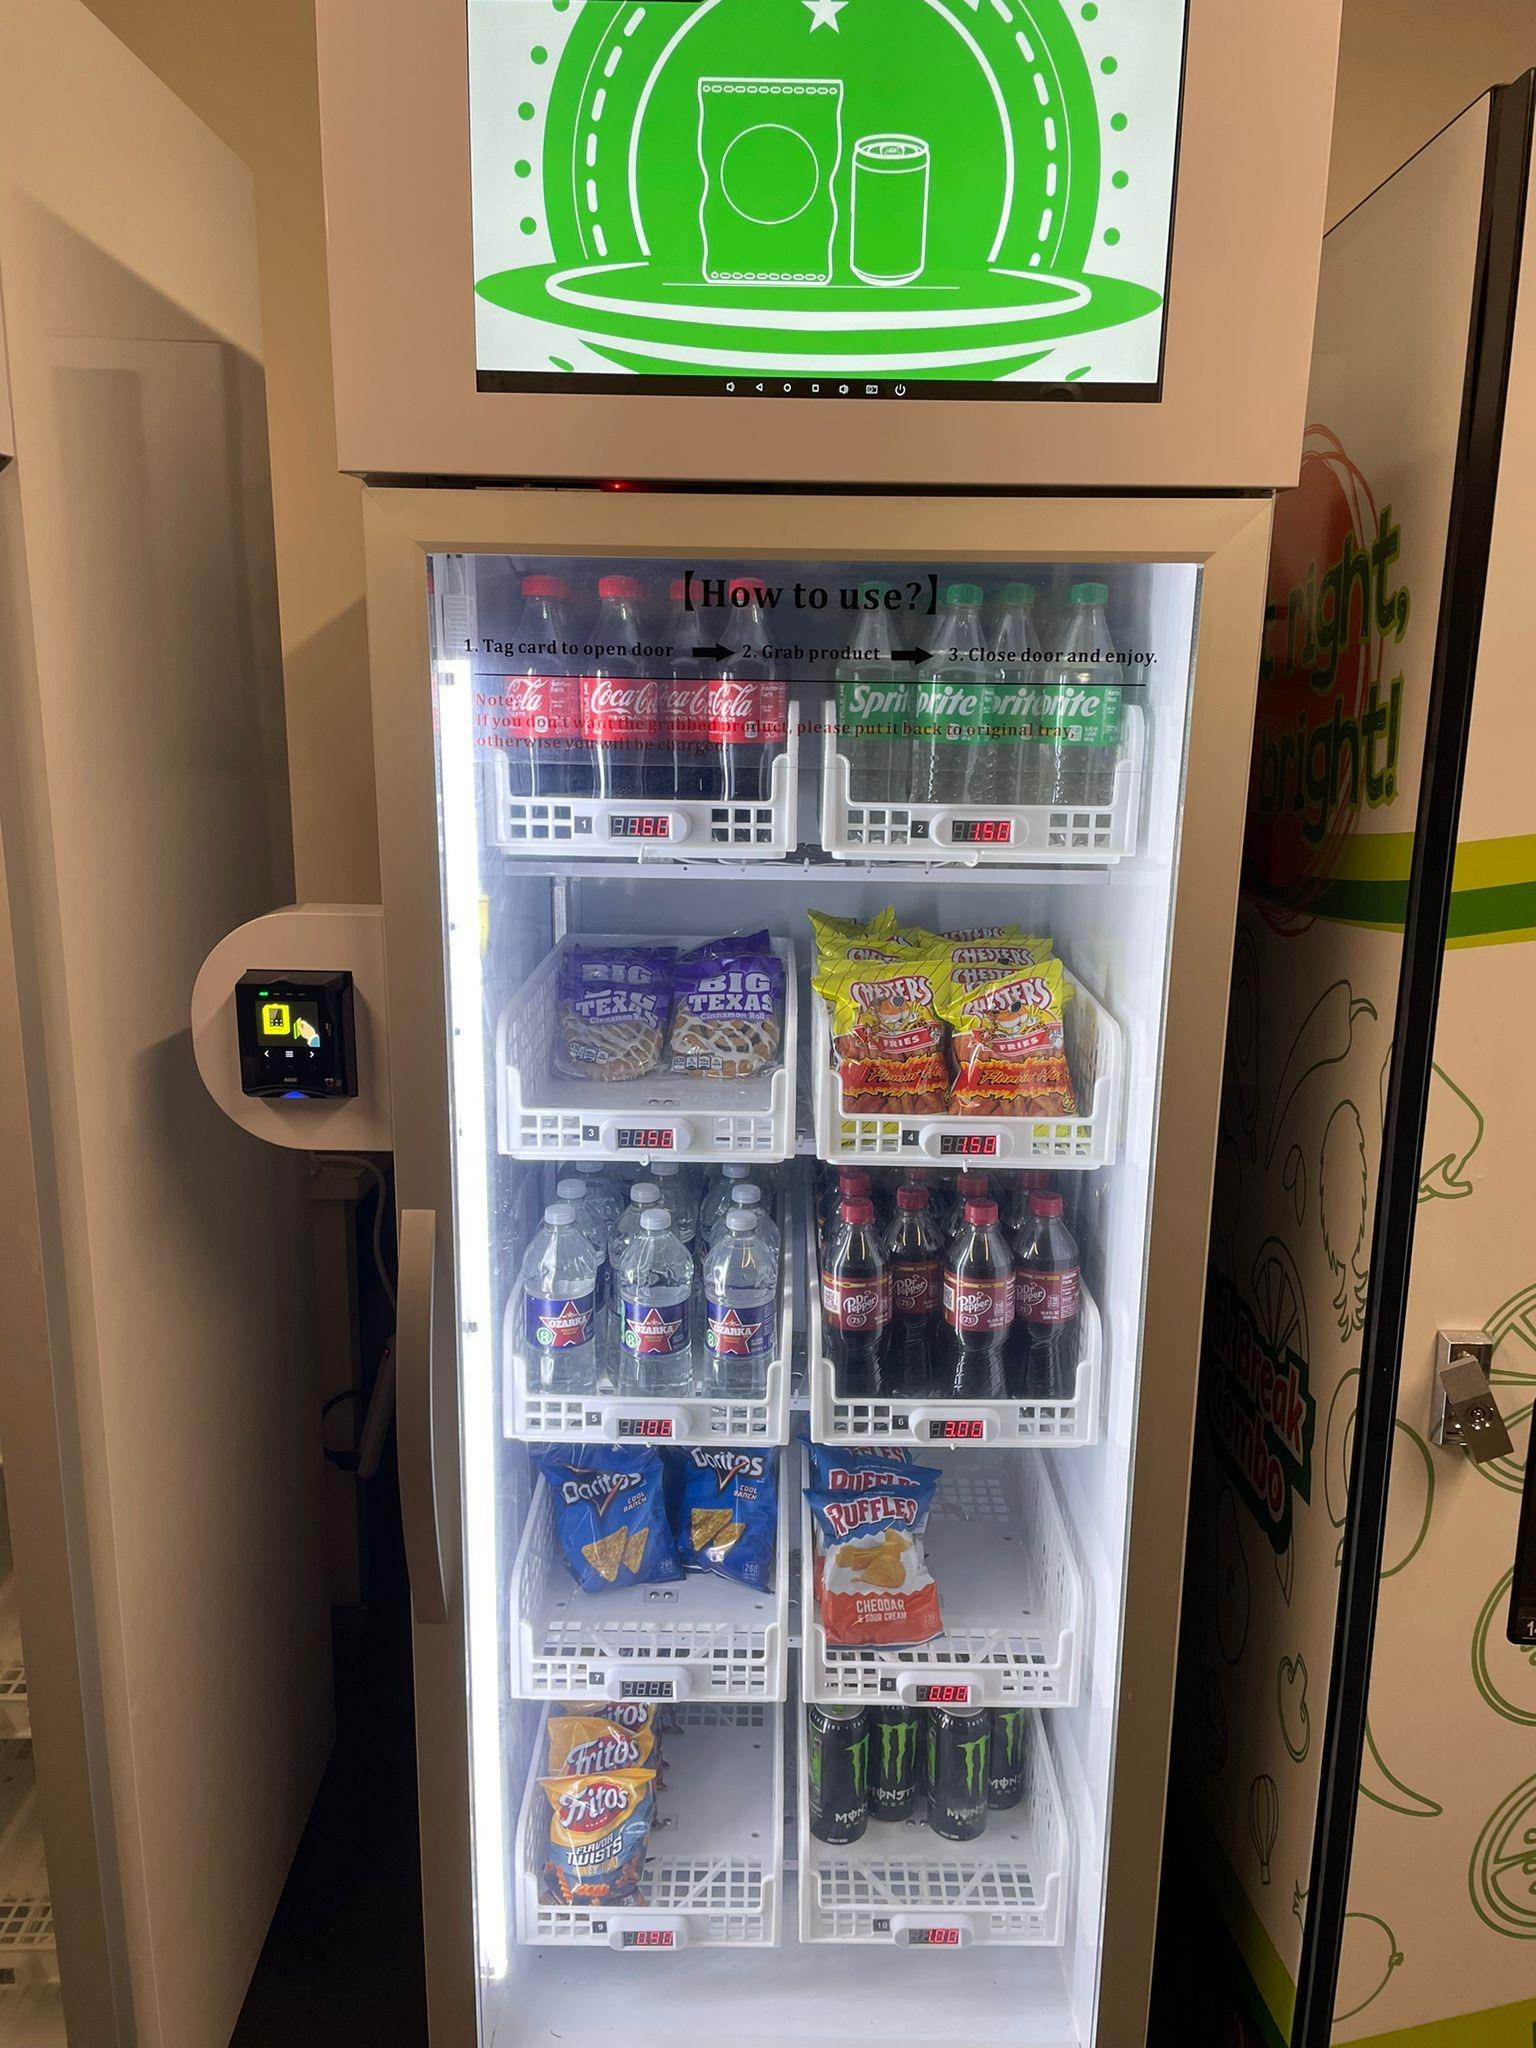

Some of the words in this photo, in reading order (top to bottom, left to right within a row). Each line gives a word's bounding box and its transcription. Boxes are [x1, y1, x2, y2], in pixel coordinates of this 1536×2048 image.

[793, 582, 828, 609] to
[1284, 504, 1412, 695] right,
[463, 638, 479, 653] 1.
[483, 638, 514, 657] Tag
[518, 640, 557, 655] card
[562, 643, 579, 656] to
[584, 644, 627, 659] open
[631, 642, 674, 657] door
[742, 644, 757, 659] 2.
[762, 644, 804, 660] Grab
[809, 646, 881, 663] product
[949, 648, 964, 662] 3.
[969, 648, 1016, 662] Close
[1021, 648, 1063, 663] door
[1067, 649, 1100, 663] and
[1105, 650, 1158, 667] enjoy.
[476, 714, 489, 727] If
[493, 716, 522, 730] you
[617, 718, 645, 730] the
[648, 718, 718, 734] grabbed
[796, 721, 850, 737] please
[855, 723, 880, 738] put
[887, 722, 898, 735] it
[902, 721, 942, 735] back
[947, 723, 962, 735] to
[966, 722, 1033, 739] original
[1038, 724, 1075, 740] tray,
[477, 734, 561, 749] otherwise
[565, 739, 594, 752] you
[602, 737, 630, 750] will
[635, 738, 653, 750] be
[917, 825, 924, 834] 2
[974, 822, 1010, 841] 1.50
[698, 971, 771, 993] BIG
[688, 993, 774, 1013] TEXAS
[700, 1011, 745, 1020] Cinnamon
[748, 1011, 765, 1020] Roll
[883, 1035, 921, 1049] FRIES
[1000, 1036, 1039, 1051] FRIES
[588, 1128, 595, 1137] 3
[907, 1133, 914, 1141] 4
[962, 1136, 995, 1153] 1.50
[894, 1280, 925, 1297] Pepper
[843, 1297, 877, 1314] Pepper
[856, 1291, 870, 1304] Dr
[958, 1296, 989, 1314] Pepper
[968, 1291, 983, 1304] Dr
[549, 1316, 588, 1328] OZARKA
[634, 1324, 675, 1335] OZARKA
[713, 1324, 752, 1336] OZARKA
[591, 1414, 598, 1422] 5
[898, 1417, 904, 1425] 6
[945, 1421, 983, 1438] 3.00
[690, 1447, 764, 1477] Doritos
[733, 1489, 758, 1501] RANCH
[739, 1484, 758, 1494] COOL
[623, 1497, 648, 1513] RANCH
[627, 1491, 645, 1505] COOL
[823, 1496, 918, 1537] RUFFLES
[855, 1598, 906, 1614] CHEDDAR
[865, 1613, 883, 1623] SOUR
[884, 1611, 907, 1621] CREAM
[594, 1674, 600, 1682] 7
[566, 1738, 639, 1776] Fritos
[559, 1786, 629, 1828] Fritos
[566, 1835, 623, 1867] TWISTS
[576, 1832, 614, 1855] FLAVOR
[877, 1921, 888, 1929] 10
